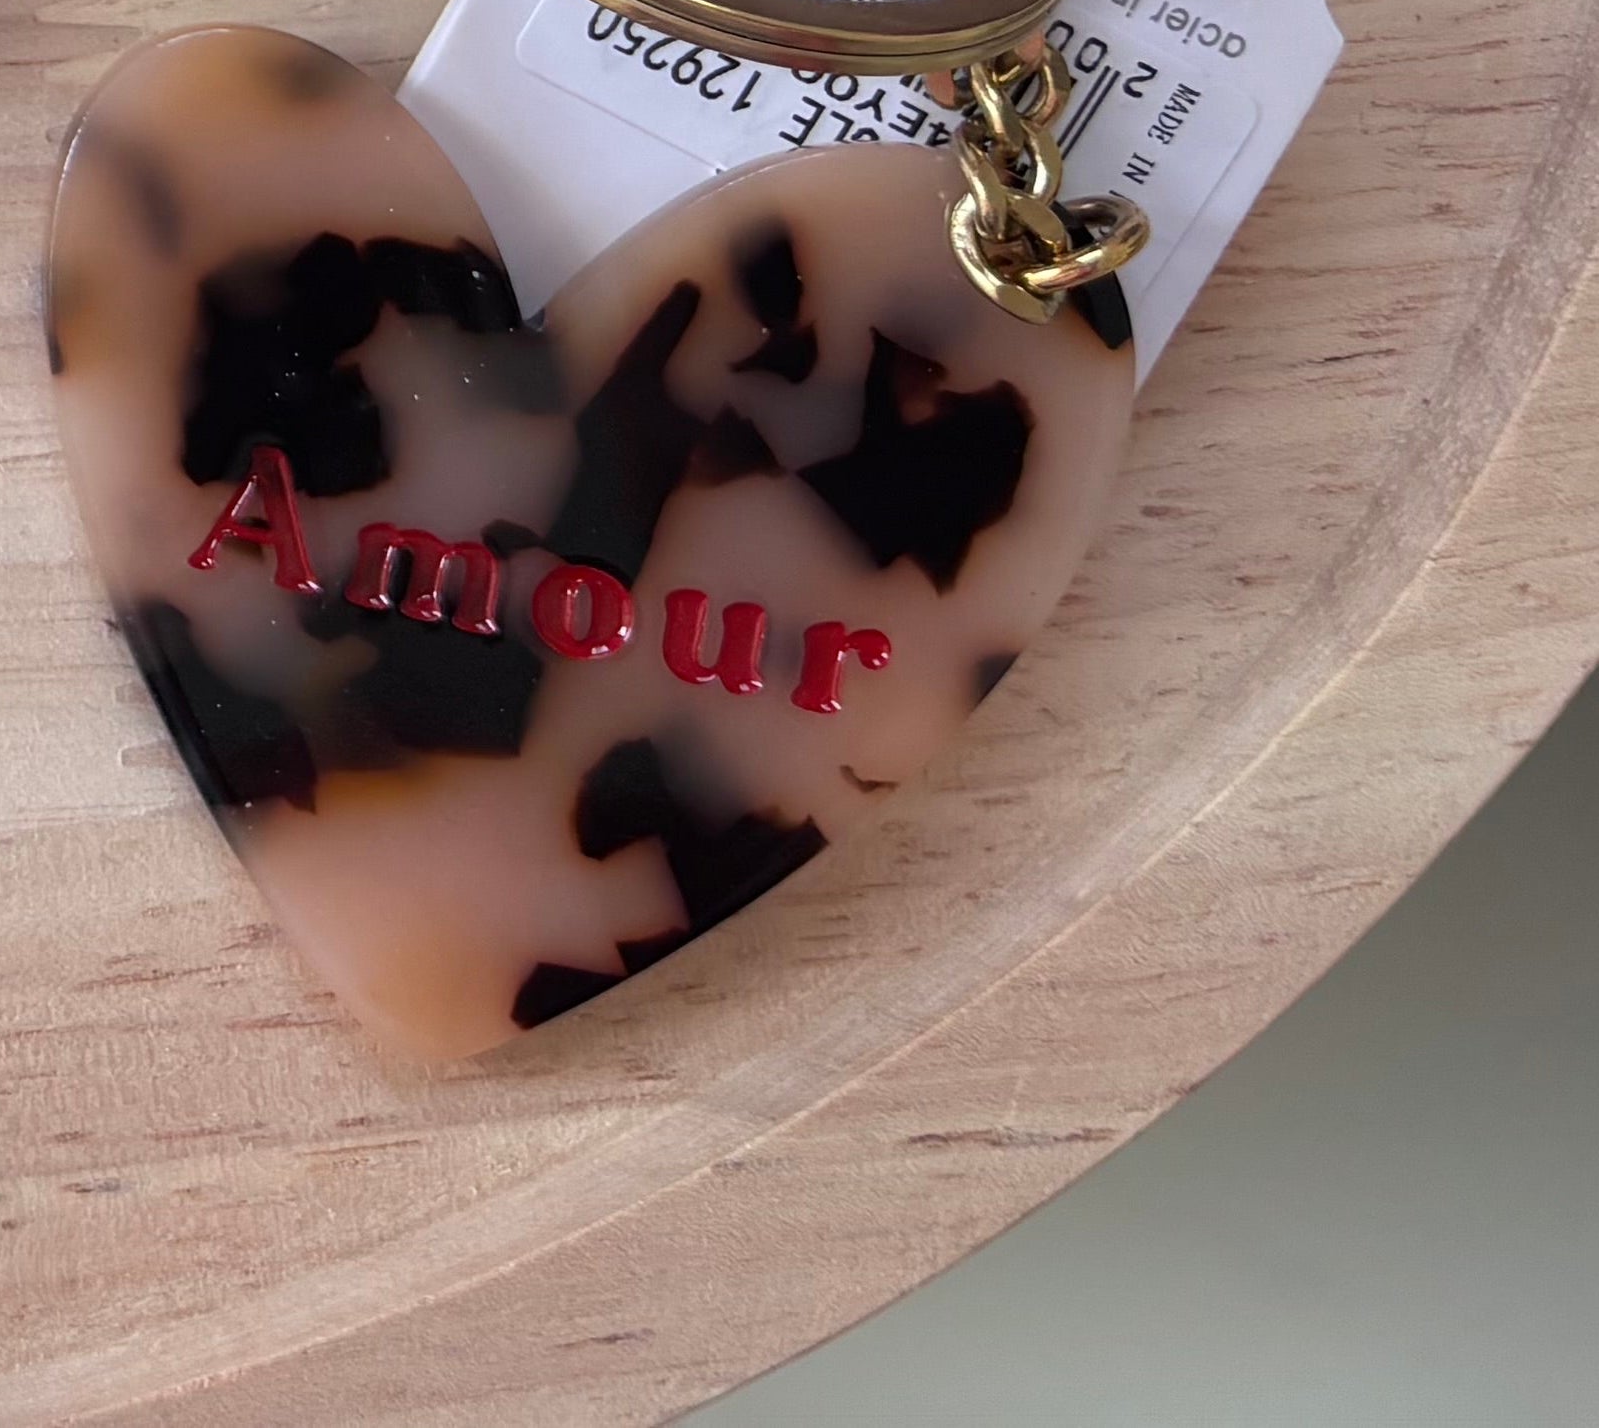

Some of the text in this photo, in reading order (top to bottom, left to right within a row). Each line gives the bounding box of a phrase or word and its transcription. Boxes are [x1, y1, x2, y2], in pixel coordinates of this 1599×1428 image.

[586, 5, 762, 113] 129250
[1121, 60, 1158, 99] 2
[1119, 82, 1203, 186] MADE IN
[183, 442, 893, 717] Amour
